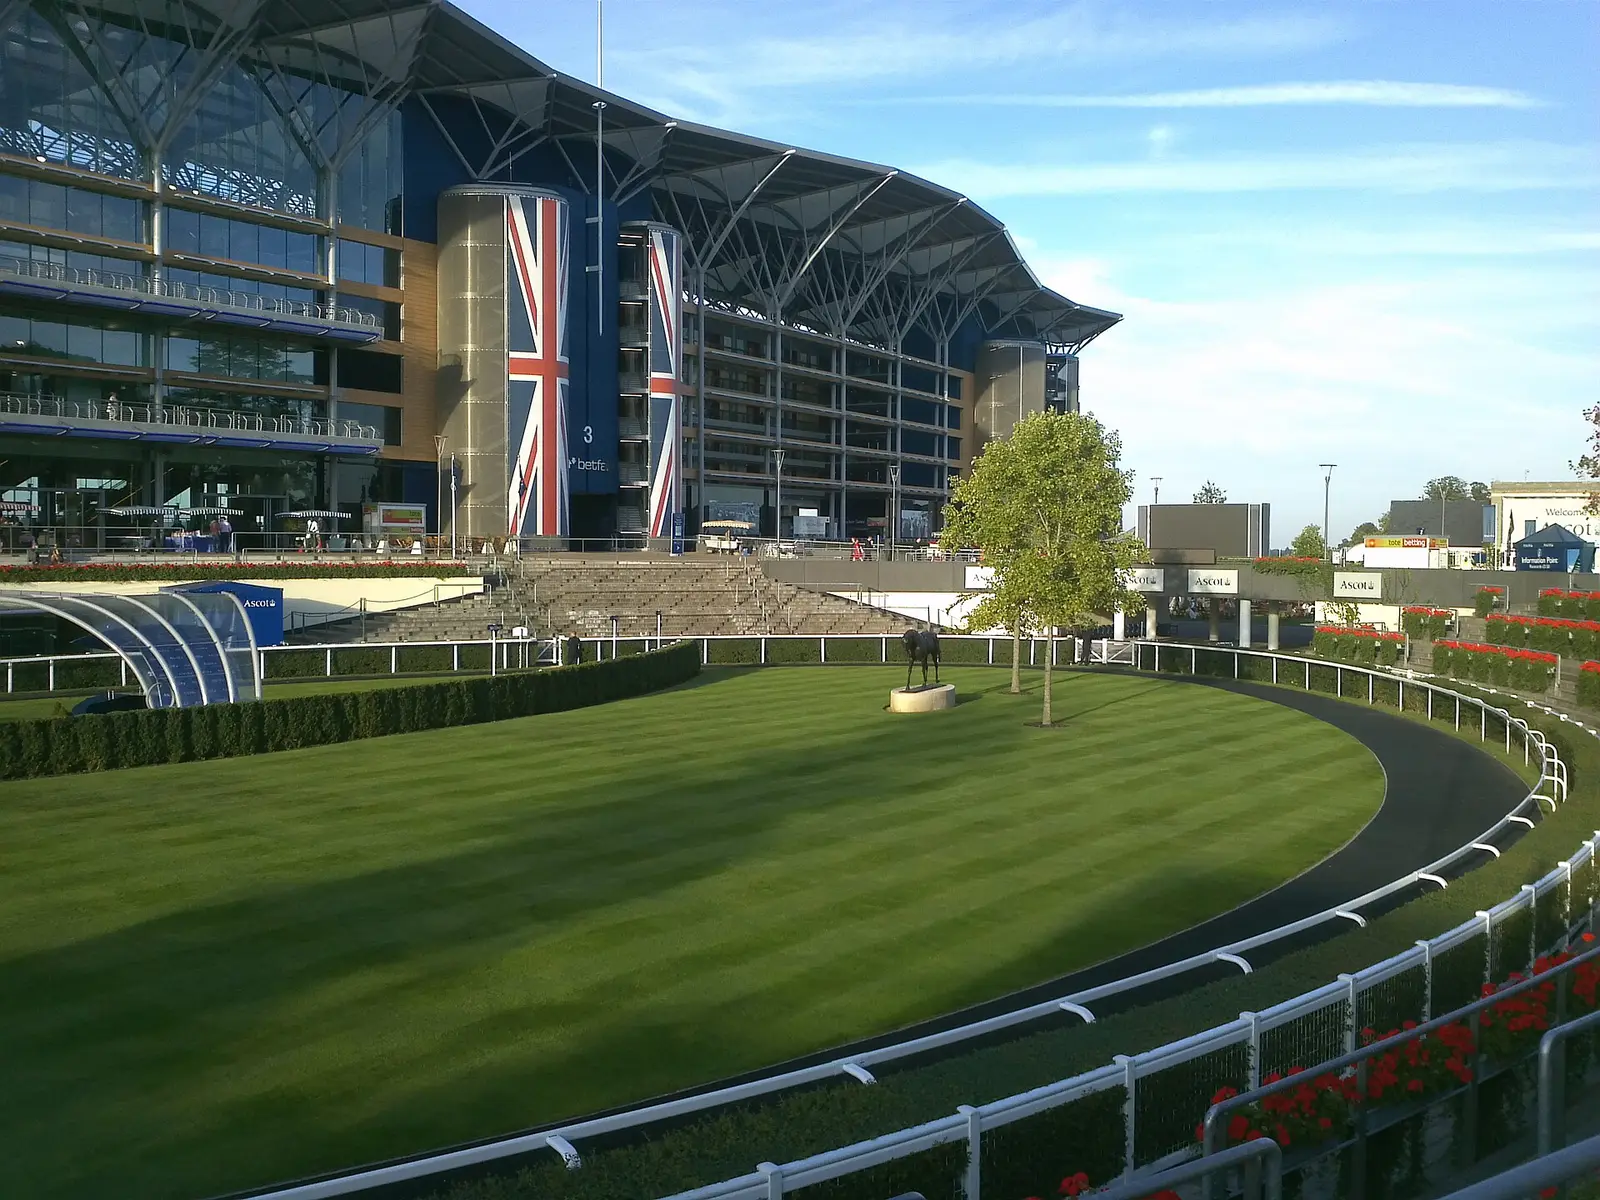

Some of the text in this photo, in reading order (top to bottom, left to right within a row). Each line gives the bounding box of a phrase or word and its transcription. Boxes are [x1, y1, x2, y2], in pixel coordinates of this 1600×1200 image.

[583, 425, 593, 444] 3
[1545, 508, 1588, 516] Welcome
[1403, 538, 1426, 548] betting
[1521, 556, 1559, 564] Information Point
[1194, 577, 1223, 586] Ascot
[1340, 580, 1367, 590] Ascot
[243, 599, 269, 608] Ascot
